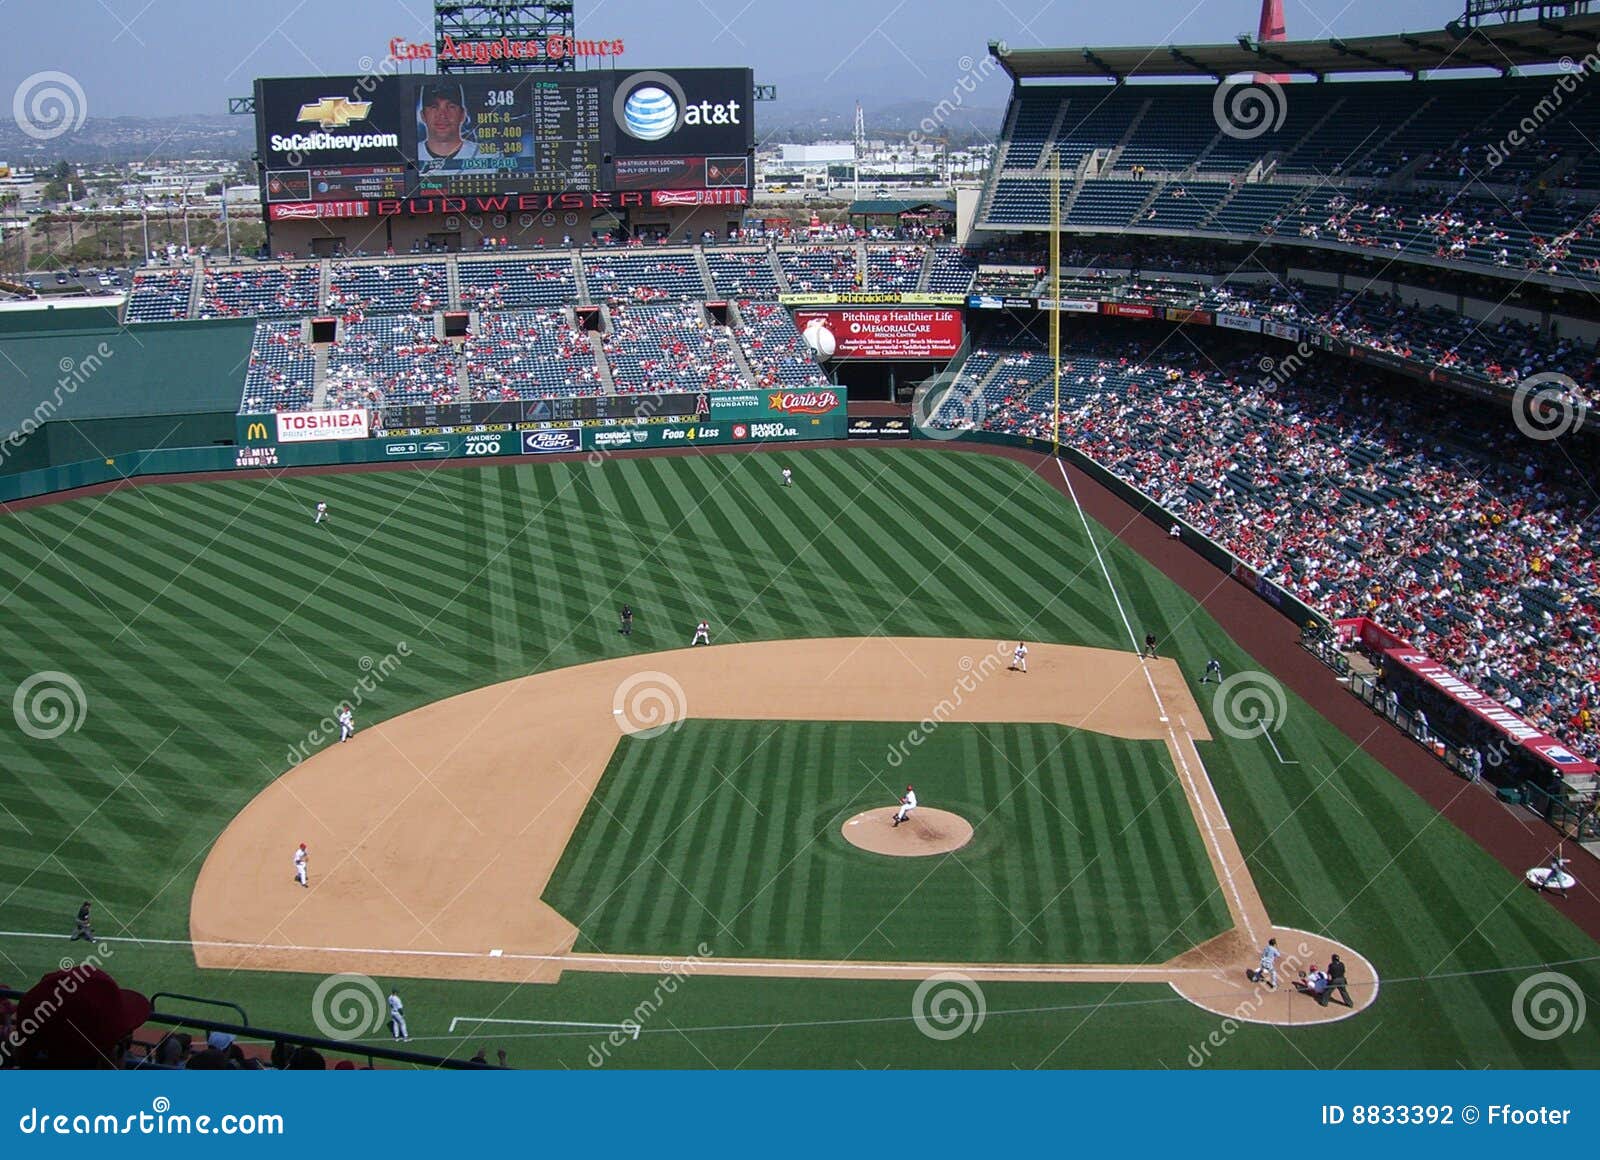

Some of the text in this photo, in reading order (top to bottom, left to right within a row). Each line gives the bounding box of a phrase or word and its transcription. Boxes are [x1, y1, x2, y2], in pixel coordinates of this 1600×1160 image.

[389, 35, 624, 64] Los Angeles Times
[484, 90, 514, 106] .348
[684, 99, 740, 125] at&t
[271, 133, 398, 151] SoCalChevy.com
[463, 158, 488, 169] JOSH
[378, 191, 643, 215] BUDWEISER
[842, 312, 880, 323] Pitching
[890, 311, 933, 321] Healthier
[935, 312, 953, 321] Life
[782, 392, 839, 409] Carl's Jr.
[282, 413, 362, 430] TOSHIBA
[538, 433, 569, 441] BUD
[686, 428, 696, 440] 4
[465, 442, 500, 455] ZOO
[533, 439, 574, 447] LIGHT
[239, 446, 276, 457] FAMILY
[235, 456, 278, 466] SUNDAYS
